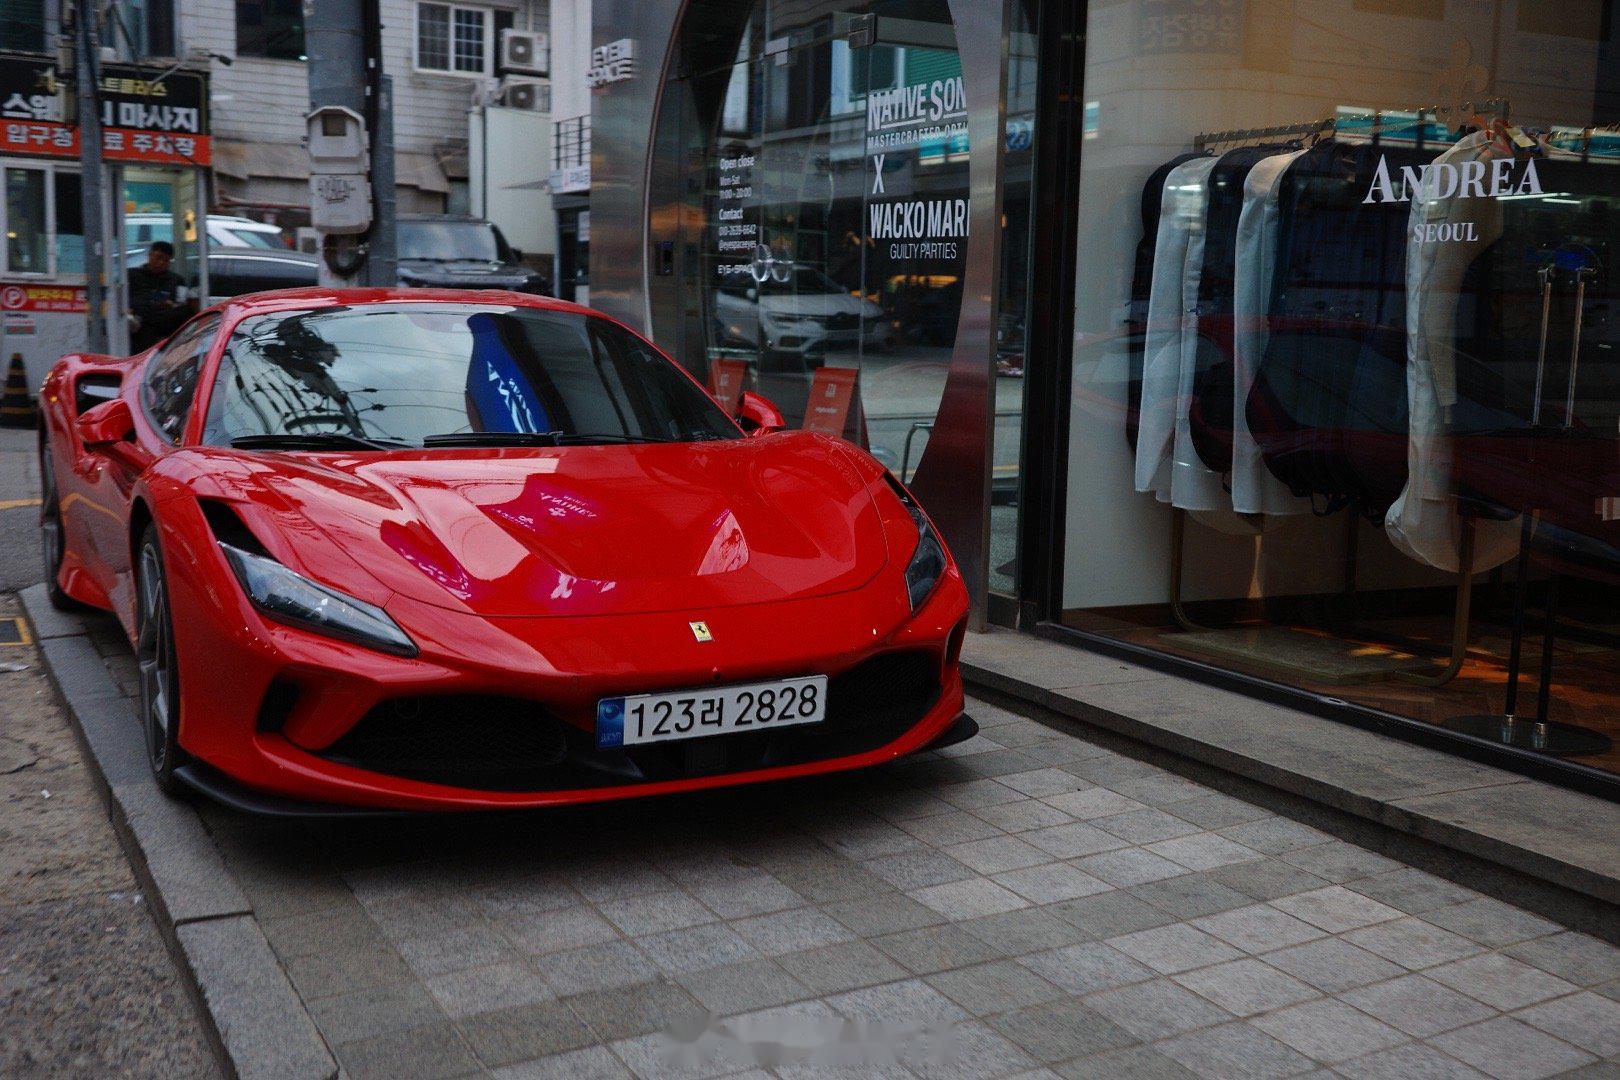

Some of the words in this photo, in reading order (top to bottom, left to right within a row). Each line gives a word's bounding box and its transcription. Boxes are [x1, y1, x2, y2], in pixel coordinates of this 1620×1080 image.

[868, 83, 927, 131] NATIVE
[930, 76, 967, 121] SON
[118, 102, 199, 133] 마사지
[7, 124, 73, 147] 압구정
[868, 127, 941, 150] MASTERCRAFTED
[720, 158, 737, 171] Open
[872, 153, 886, 194] X
[1362, 153, 1544, 204] ANDREA
[719, 208, 743, 220] Contact
[870, 201, 925, 239] WACKO
[1413, 222, 1478, 243] SEOUL
[890, 243, 919, 260] GUILTY
[920, 242, 957, 260] PARTIES
[632, 697, 724, 737] 123러
[735, 684, 818, 726] 2828
